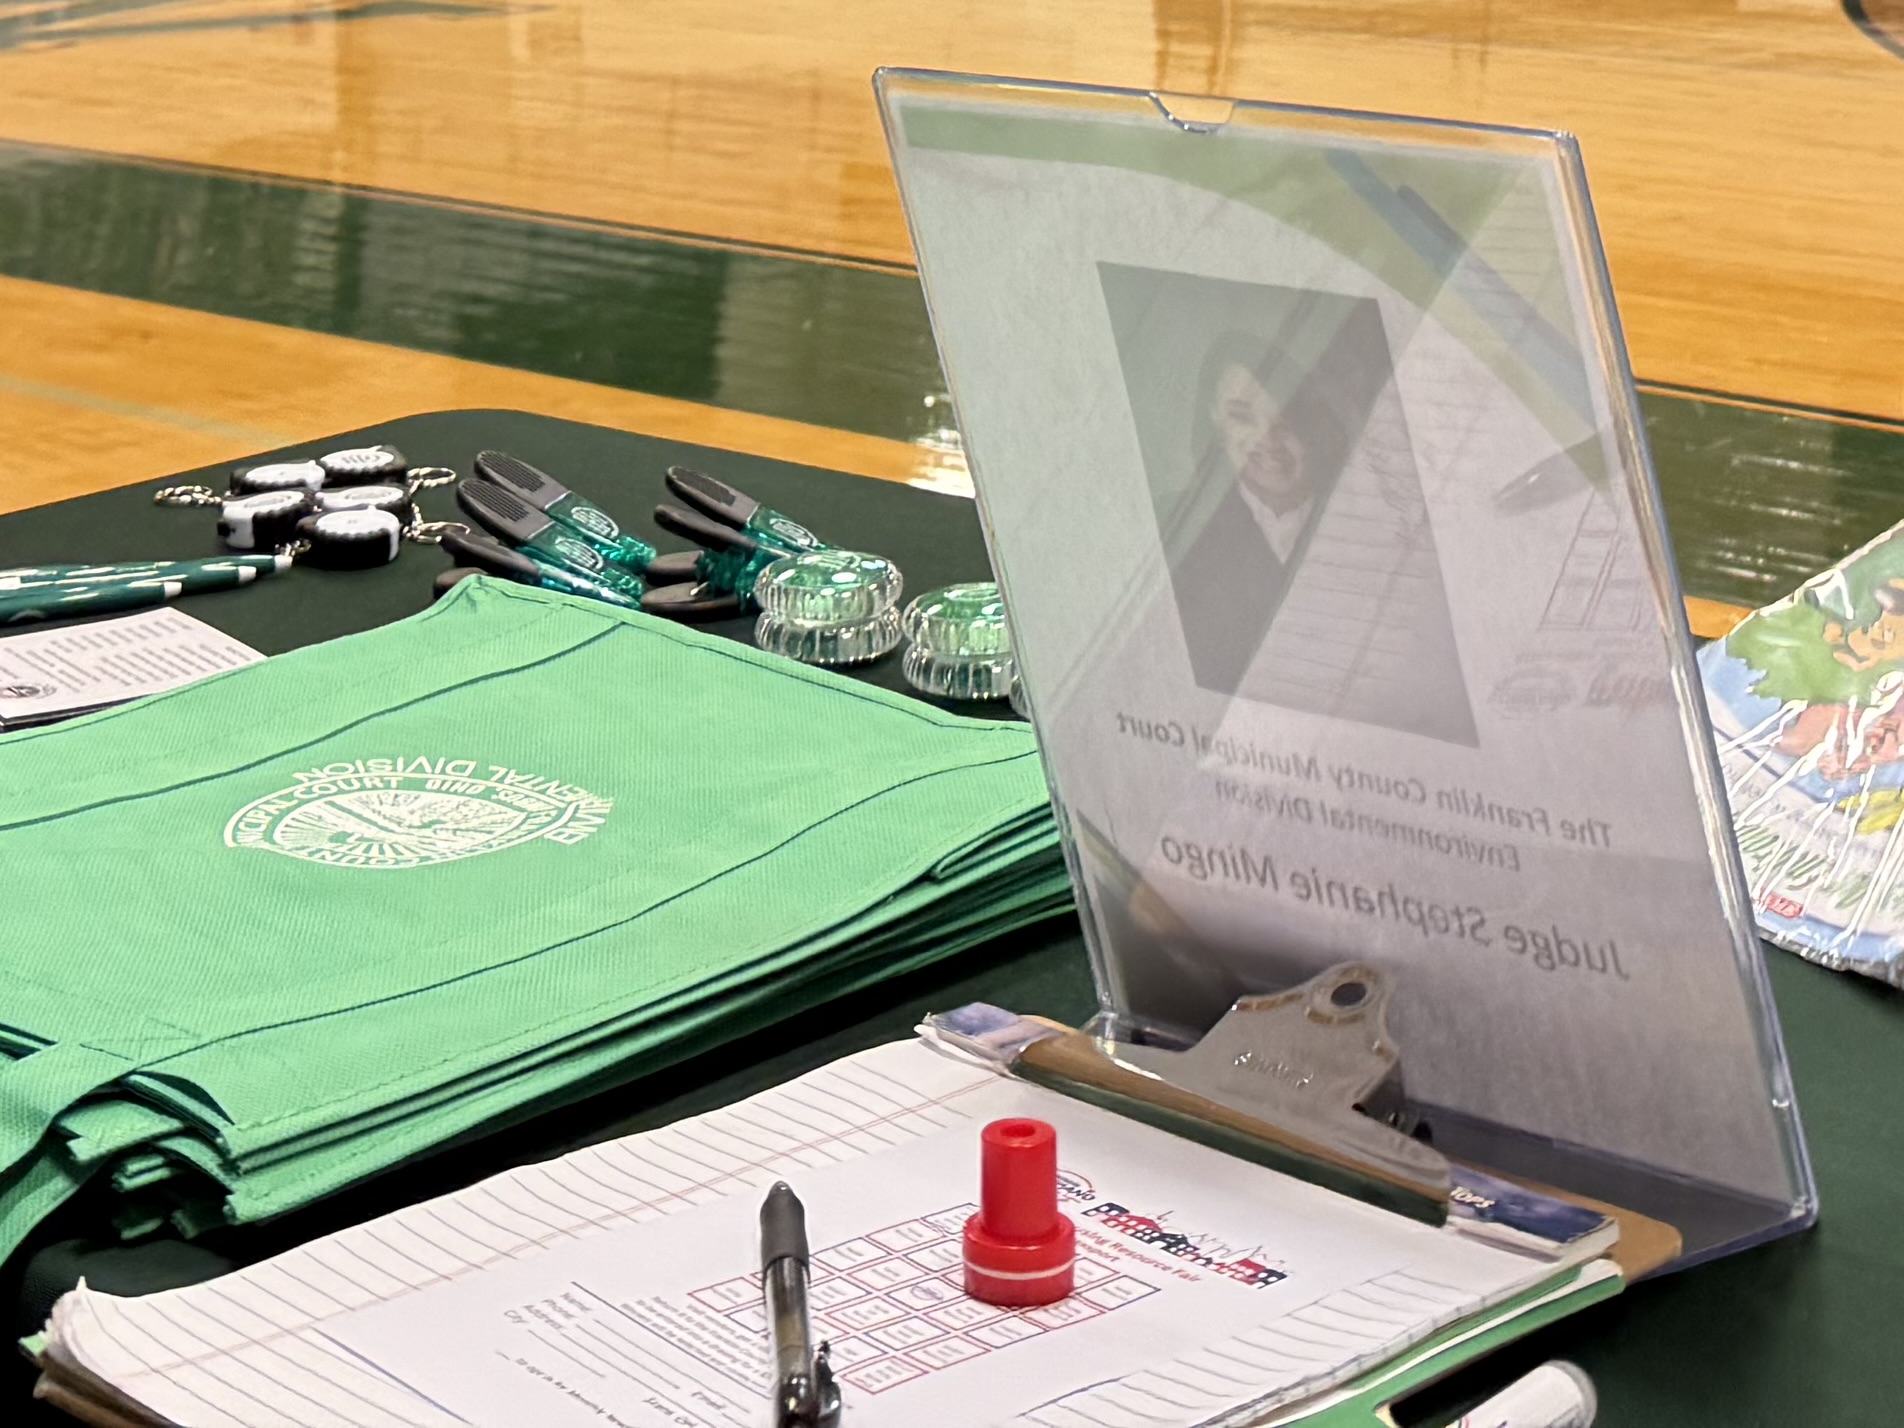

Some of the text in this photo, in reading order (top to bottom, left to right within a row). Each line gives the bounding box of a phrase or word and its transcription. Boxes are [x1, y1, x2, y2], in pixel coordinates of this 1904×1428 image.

[293, 756, 477, 783] DIVISION
[293, 775, 404, 800] COURT
[1450, 1186, 1495, 1209] TOPS
[1110, 1242, 1173, 1272] Resource
[1173, 1269, 1201, 1282] Fair
